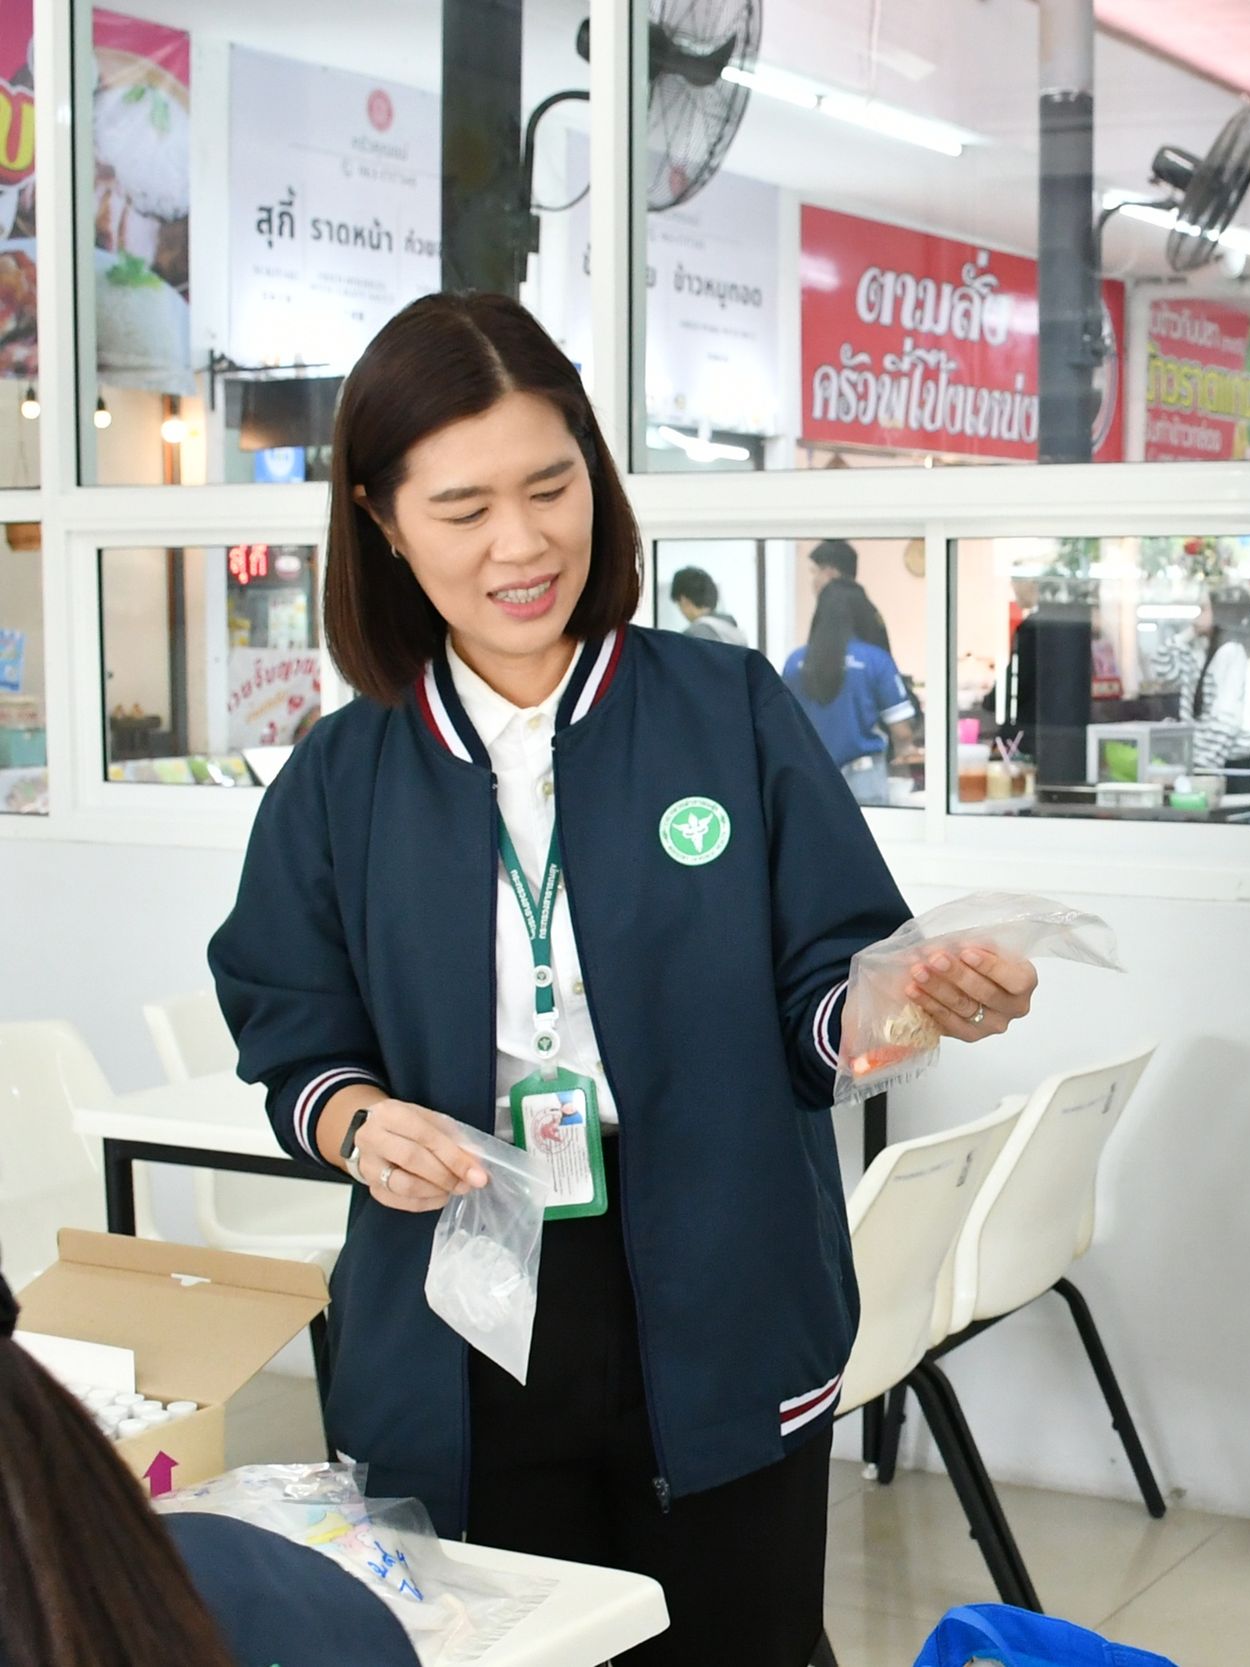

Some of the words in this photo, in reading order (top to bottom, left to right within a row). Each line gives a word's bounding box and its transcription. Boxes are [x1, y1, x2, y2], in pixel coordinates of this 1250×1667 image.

[255, 186, 297, 249] สุกี้
[310, 217, 394, 253] ราดหน้า
[855, 250, 1011, 347] ตามสั่ง
